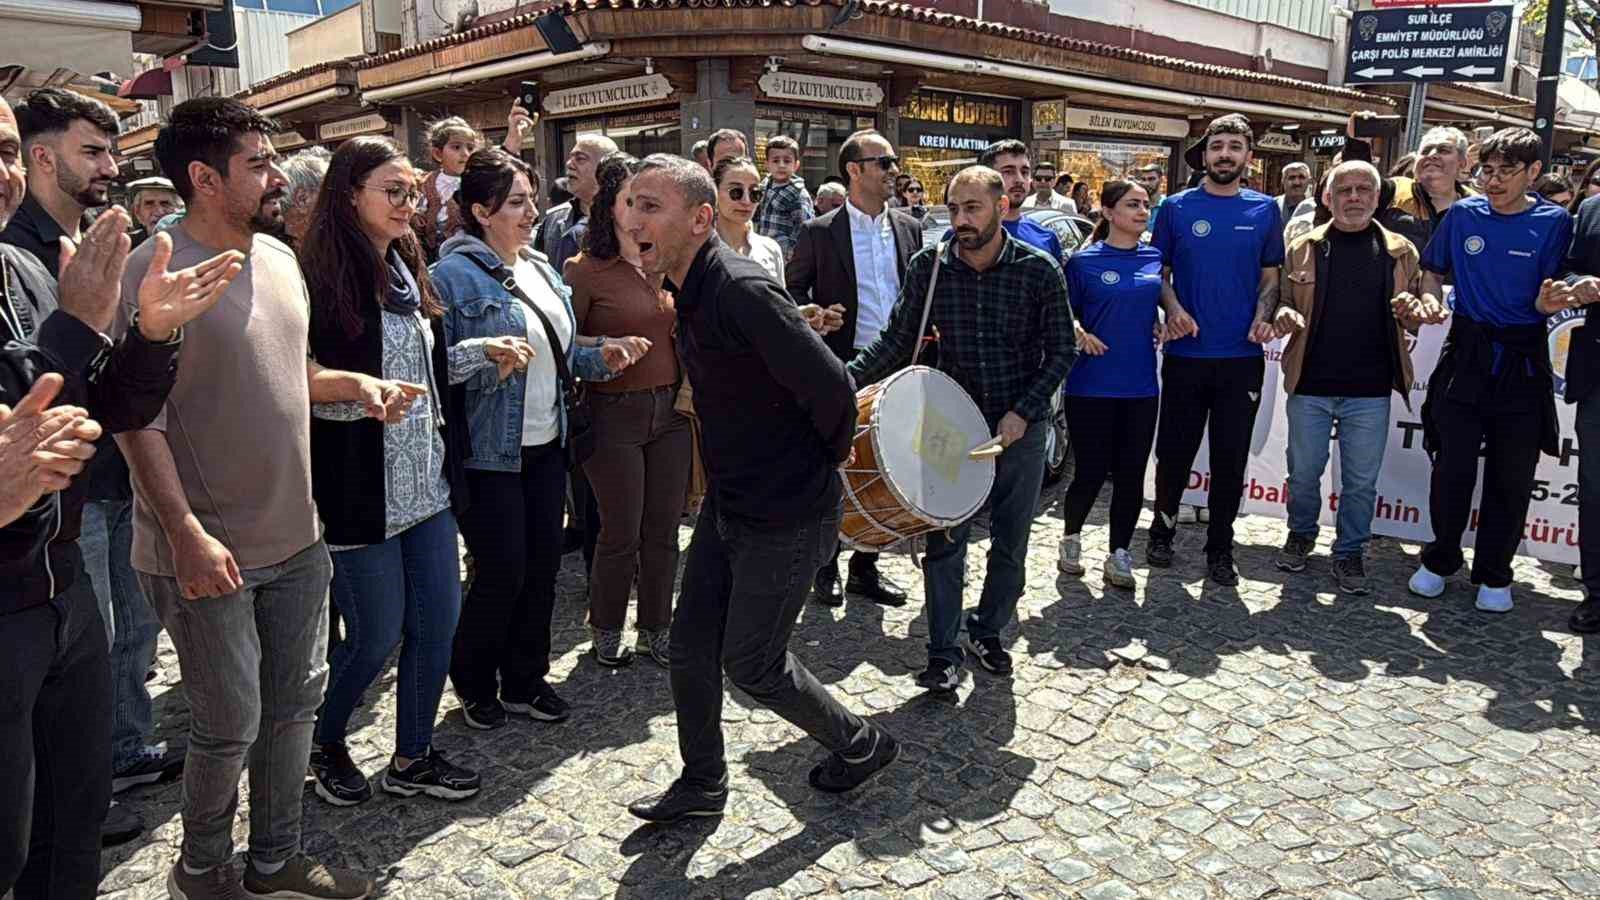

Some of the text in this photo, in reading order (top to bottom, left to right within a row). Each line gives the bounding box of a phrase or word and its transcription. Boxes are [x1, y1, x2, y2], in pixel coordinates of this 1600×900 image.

[1408, 10, 1452, 25] SUR İLÇE
[1376, 28, 1484, 43] EMNİYET MÜDÜRLÜĞÜ
[1351, 44, 1504, 62] ÇARŞI POLİS MERKEZİ AMİRLİĞİ
[578, 83, 649, 106] KUYUMCULUK
[782, 77, 865, 102] LİZ KUYUMCULUK
[919, 134, 949, 148] KREDİ
